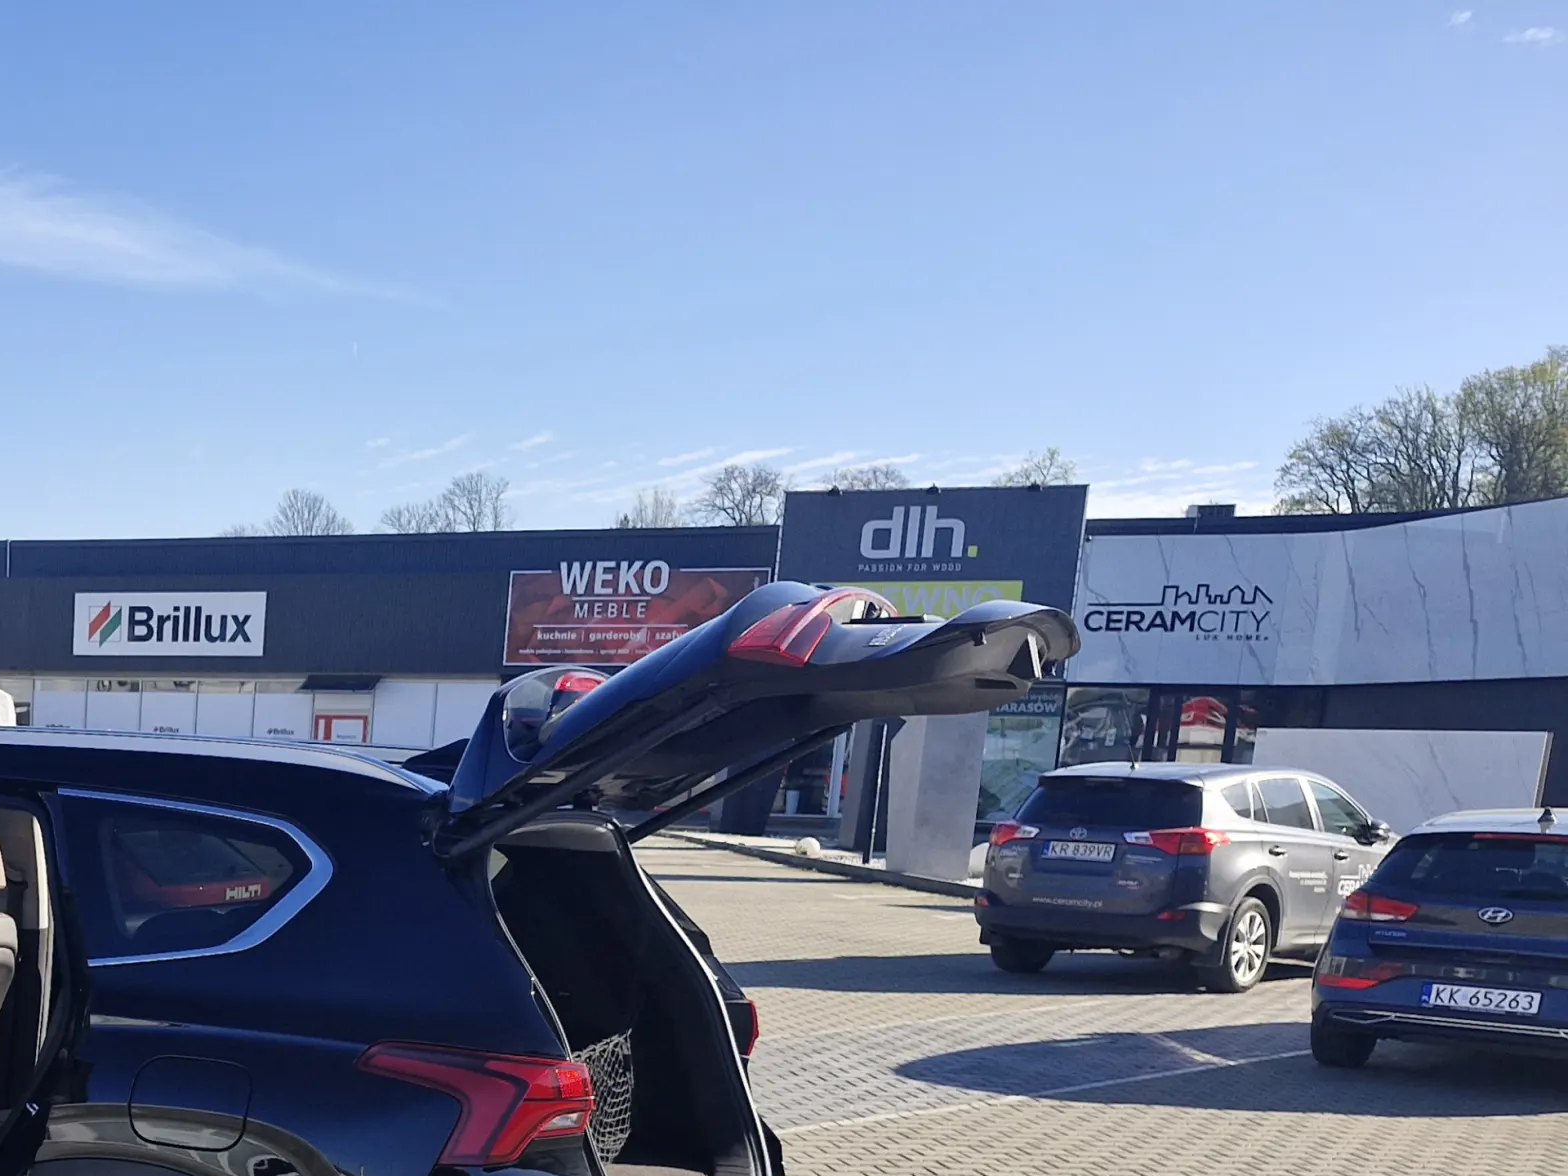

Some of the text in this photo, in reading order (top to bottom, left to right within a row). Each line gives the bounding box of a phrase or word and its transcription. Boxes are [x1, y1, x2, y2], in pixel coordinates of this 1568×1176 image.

[858, 563, 962, 572] PASSION FOR WOOD
[560, 560, 670, 595] WEKO
[574, 602, 647, 618] MEBLE
[127, 606, 252, 643] Brillux
[1084, 610, 1270, 632] CERAMCITY
[537, 629, 577, 640] kuchnie
[589, 629, 641, 643] garderoby
[996, 701, 1057, 713] ARASÓW
[1050, 842, 1069, 855] KR
[1073, 843, 1113, 858] 839VR
[226, 883, 261, 901] HILTI
[1434, 987, 1461, 1005] KK
[1468, 989, 1534, 1011] 65263
